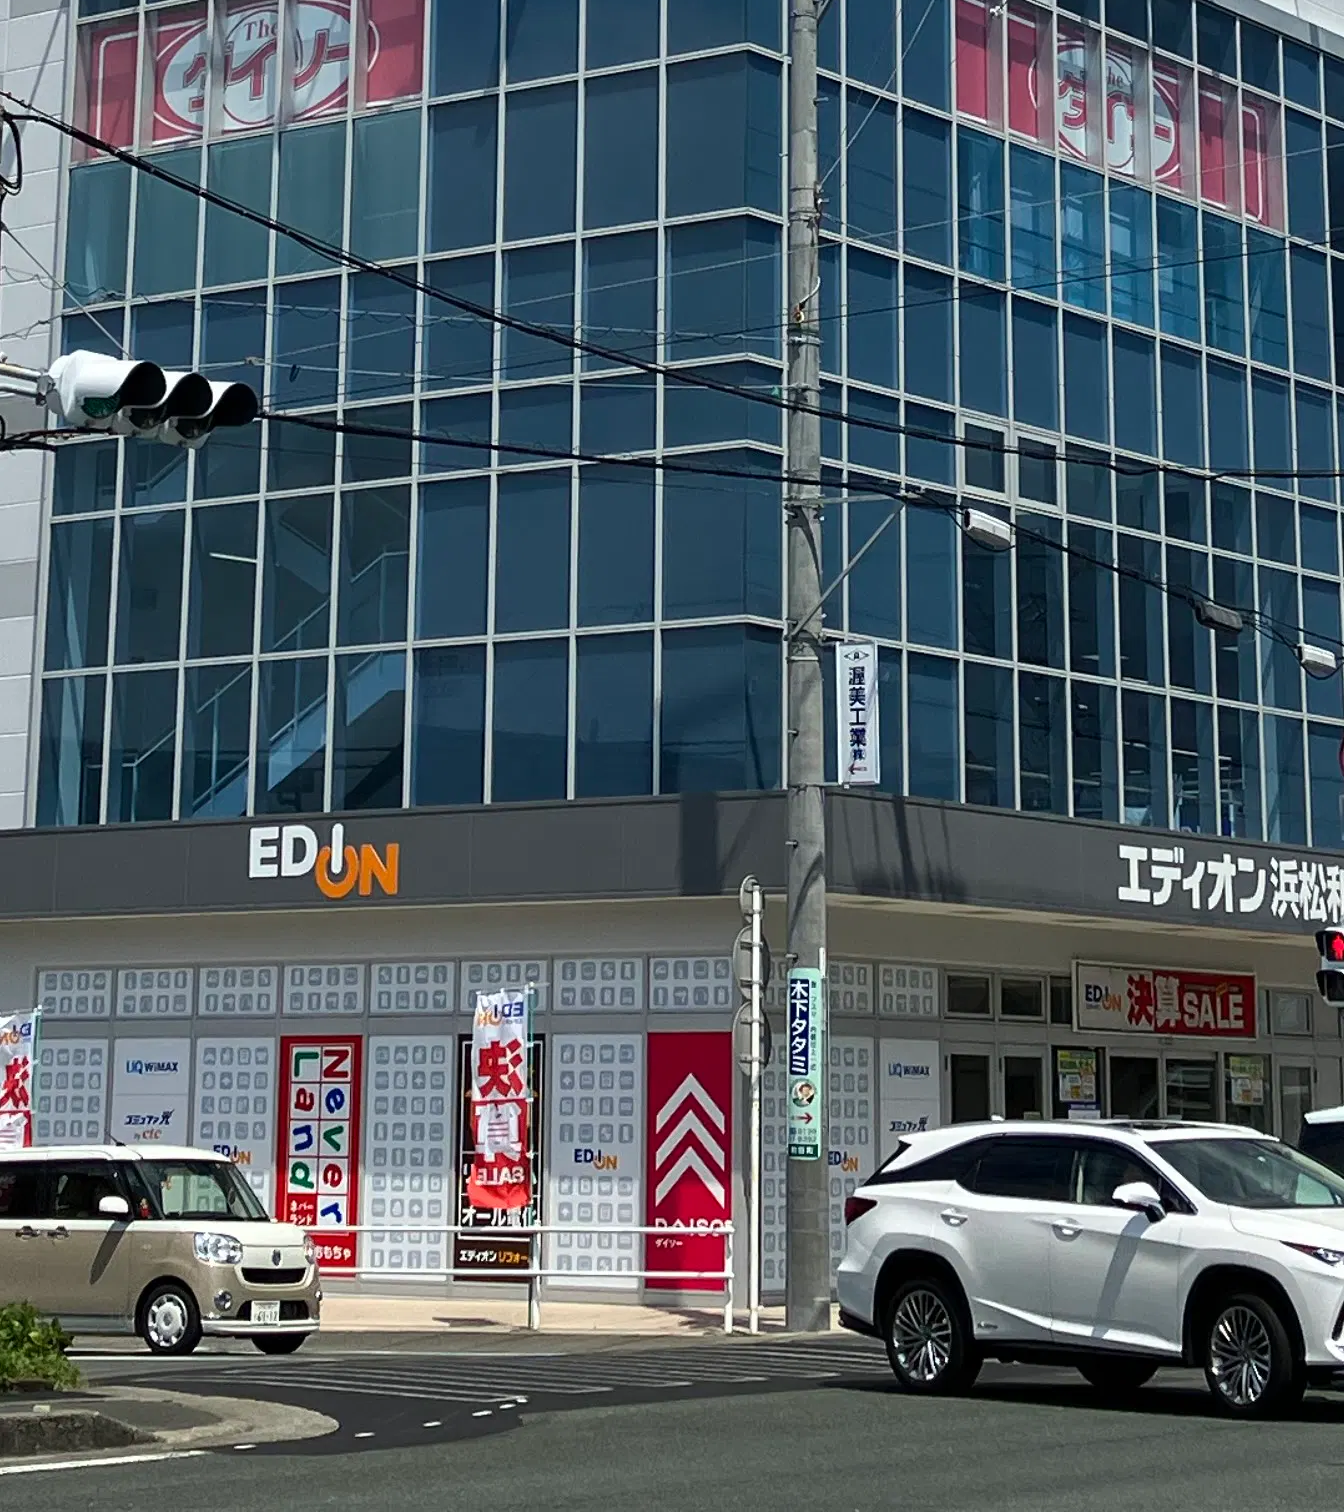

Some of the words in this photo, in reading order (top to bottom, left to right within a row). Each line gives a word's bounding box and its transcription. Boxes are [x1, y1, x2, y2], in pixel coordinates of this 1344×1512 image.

[1107, 65, 1124, 87] he
[248, 822, 400, 899] EDION
[790, 980, 809, 1073] 木下タタミ
[1085, 983, 1122, 1012] EDION
[1127, 974, 1181, 1027] 決算
[1183, 991, 1244, 1030] SALE
[289, 1050, 320, 1190] Land
[320, 1049, 350, 1224] Never
[574, 1148, 618, 1171] EDION
[655, 1238, 684, 1249] ダイソー
